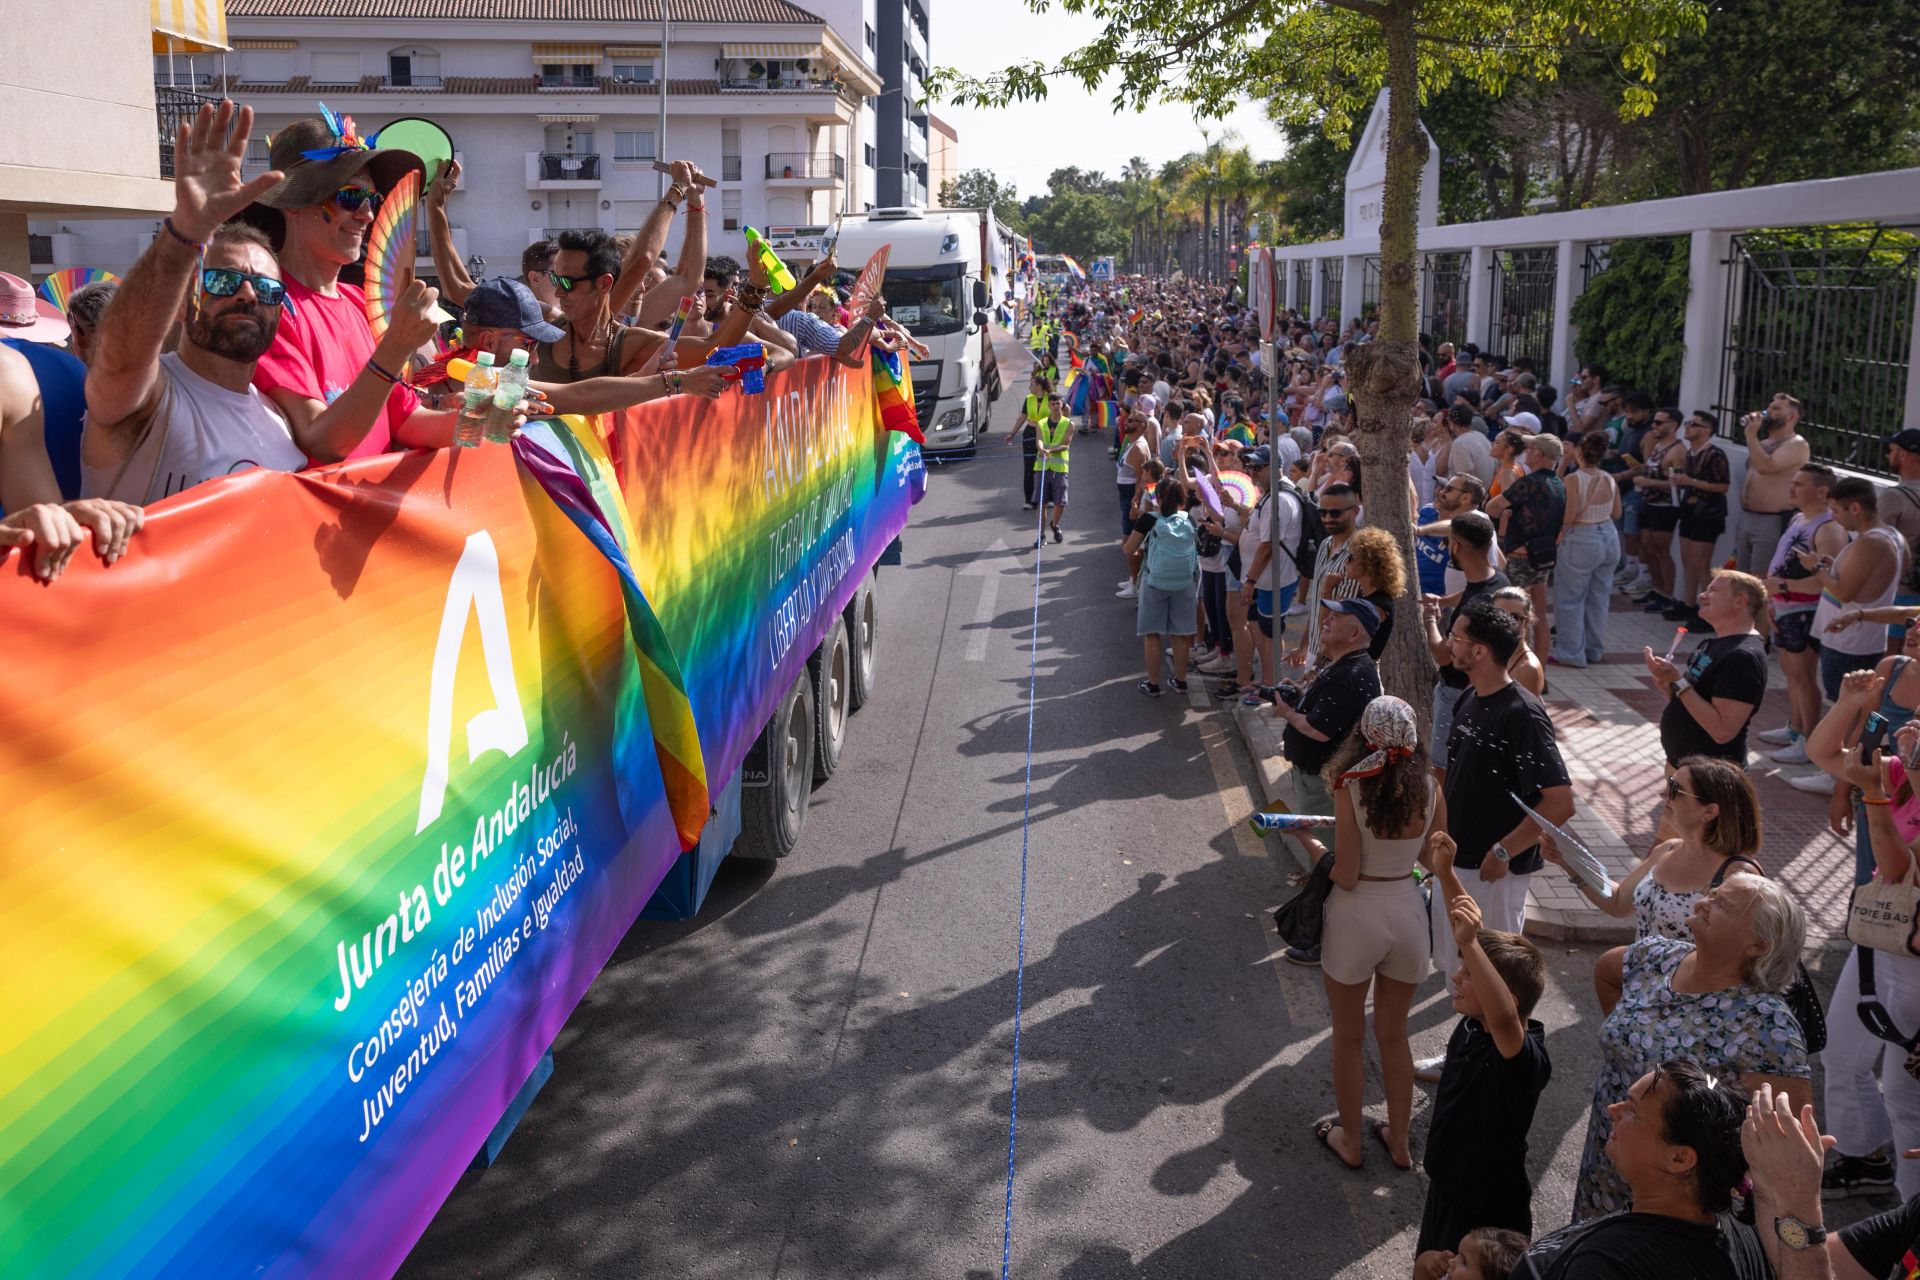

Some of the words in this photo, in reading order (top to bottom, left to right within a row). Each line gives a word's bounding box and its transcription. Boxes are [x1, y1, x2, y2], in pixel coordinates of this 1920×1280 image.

[769, 507, 805, 590] TIERRA
[806, 494, 821, 551] DE
[768, 578, 811, 671] LIBERTAD
[810, 568, 817, 613] Y
[334, 884, 432, 1012] Junta
[433, 843, 466, 907] de
[471, 730, 577, 872] Andalucía
[1854, 906, 1880, 919] TOTE
[1882, 912, 1909, 924] BAG
[1874, 900, 1893, 911] THE
[348, 949, 447, 1083] Consejería
[452, 927, 475, 966] de
[477, 853, 537, 941] Inclusión
[537, 806, 578, 867] Social,
[359, 1001, 457, 1142] Juventud,
[455, 927, 520, 1019] Familias
[522, 915, 532, 939] e
[532, 844, 584, 930] Igualdad
